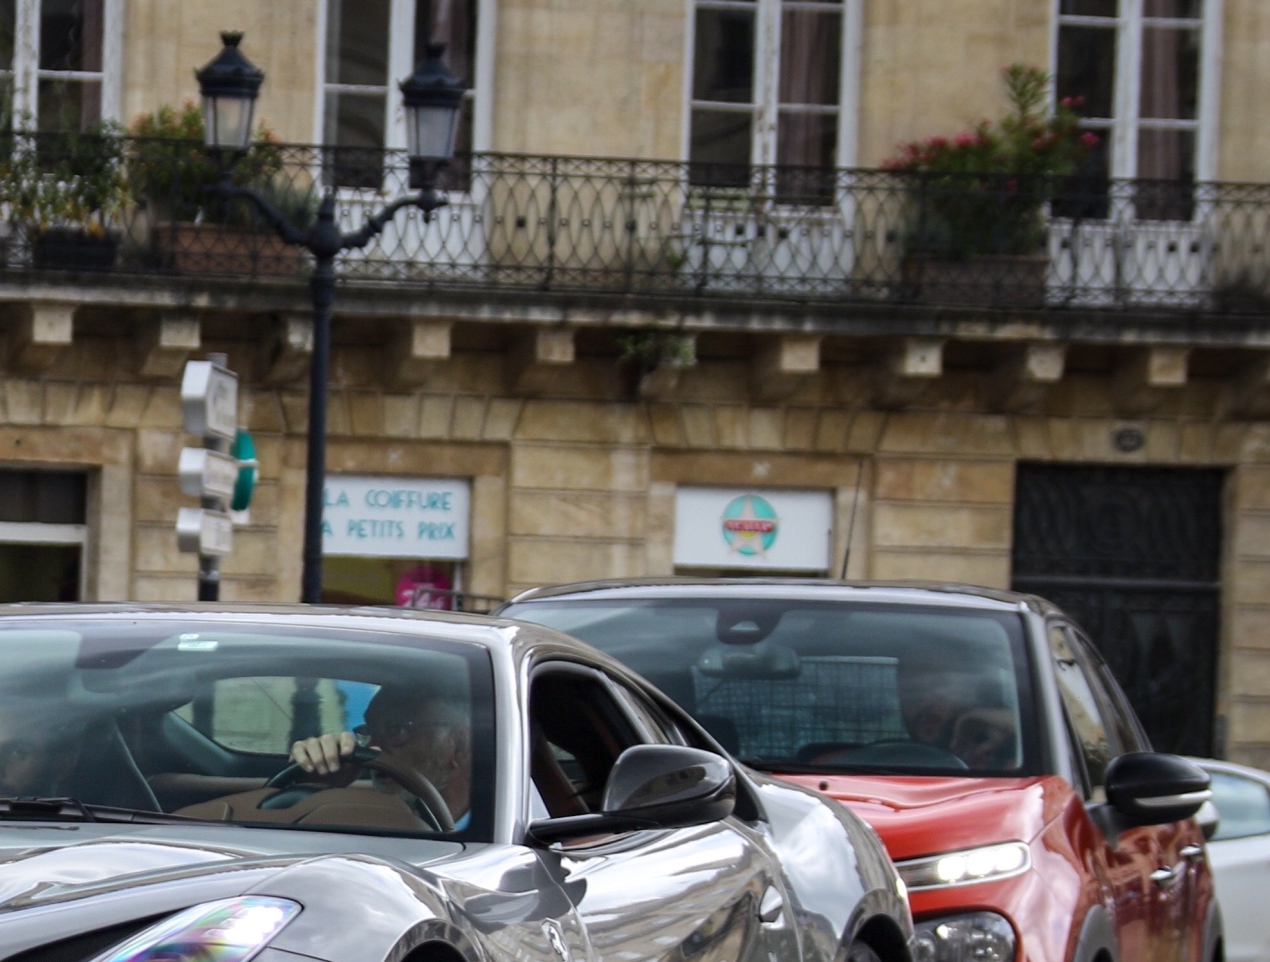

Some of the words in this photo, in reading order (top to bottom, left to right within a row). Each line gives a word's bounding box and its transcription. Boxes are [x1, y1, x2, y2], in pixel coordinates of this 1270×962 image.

[322, 488, 349, 506] LA
[365, 489, 453, 510] COIFFURE
[347, 519, 405, 538] PETITS
[417, 521, 456, 540] PRIX
